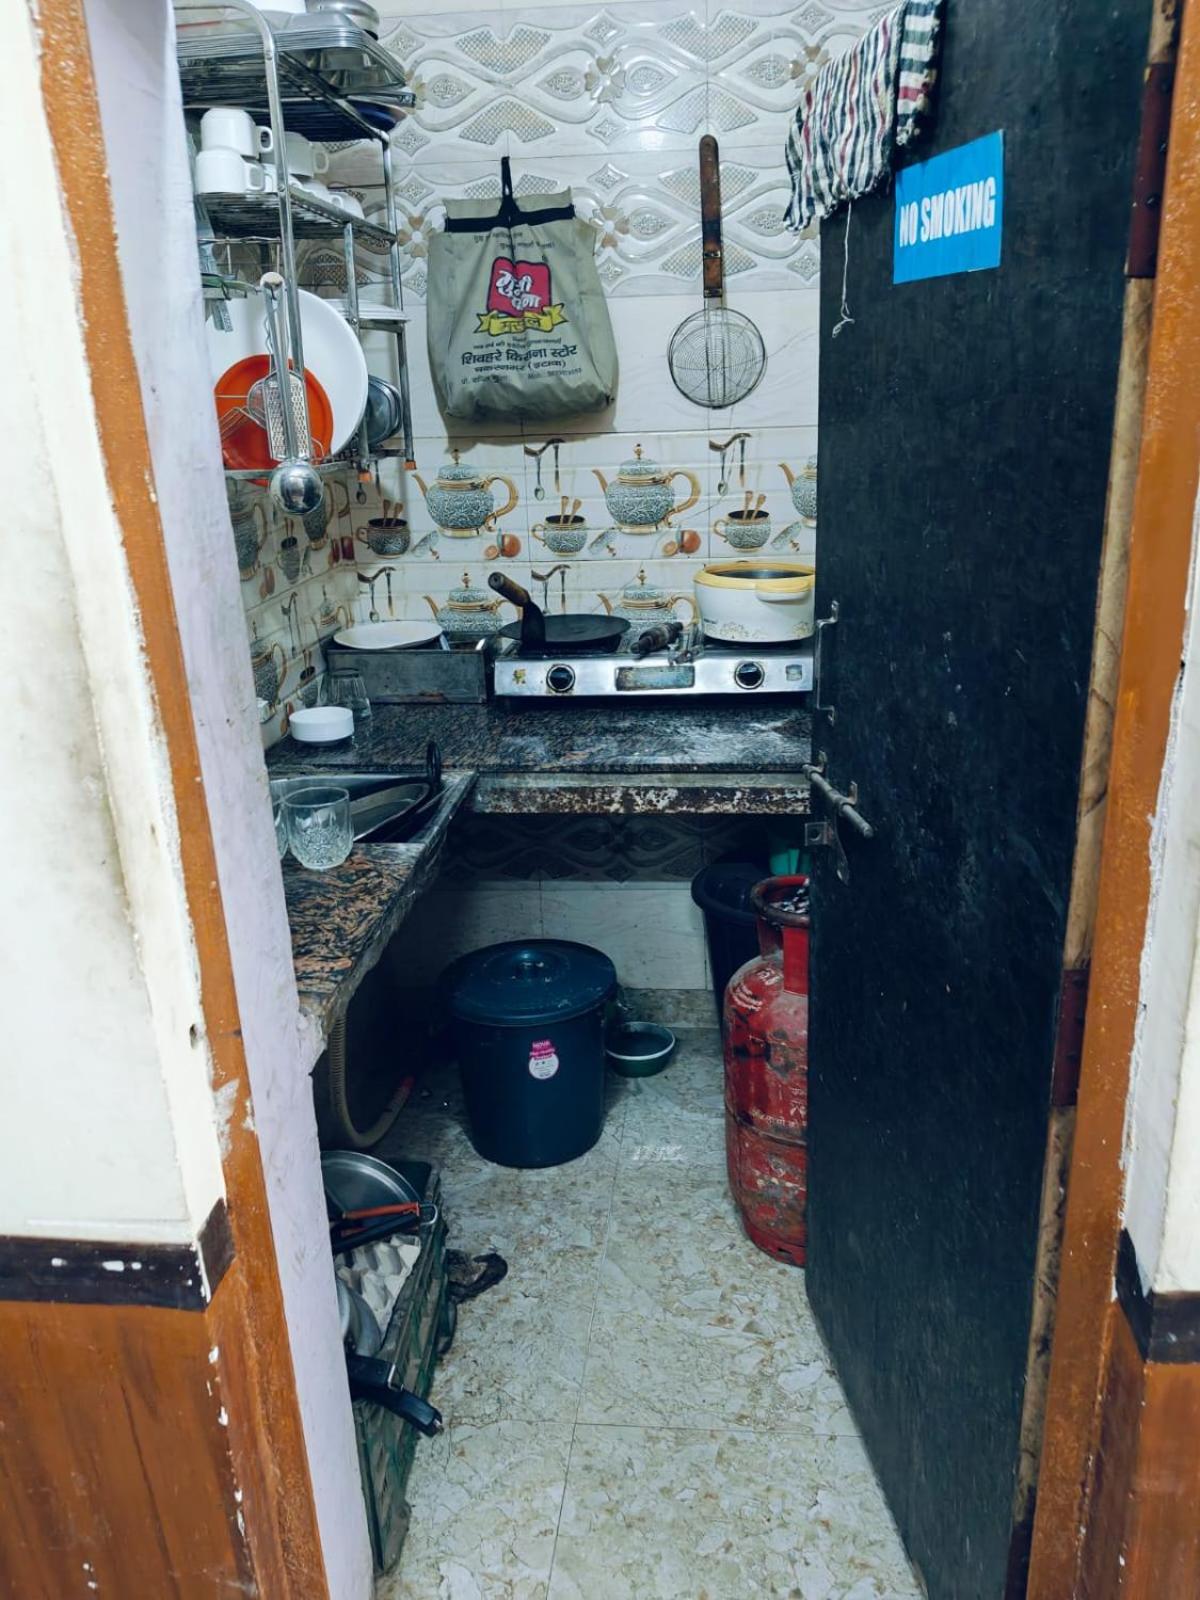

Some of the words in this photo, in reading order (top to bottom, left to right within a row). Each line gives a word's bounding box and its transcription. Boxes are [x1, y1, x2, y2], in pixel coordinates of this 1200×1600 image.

[899, 201, 919, 248] NO
[920, 176, 997, 243] SMOKING
[461, 349, 502, 365] शिवहरे
[506, 348, 547, 361] किराना
[551, 344, 578, 358] स्टोर
